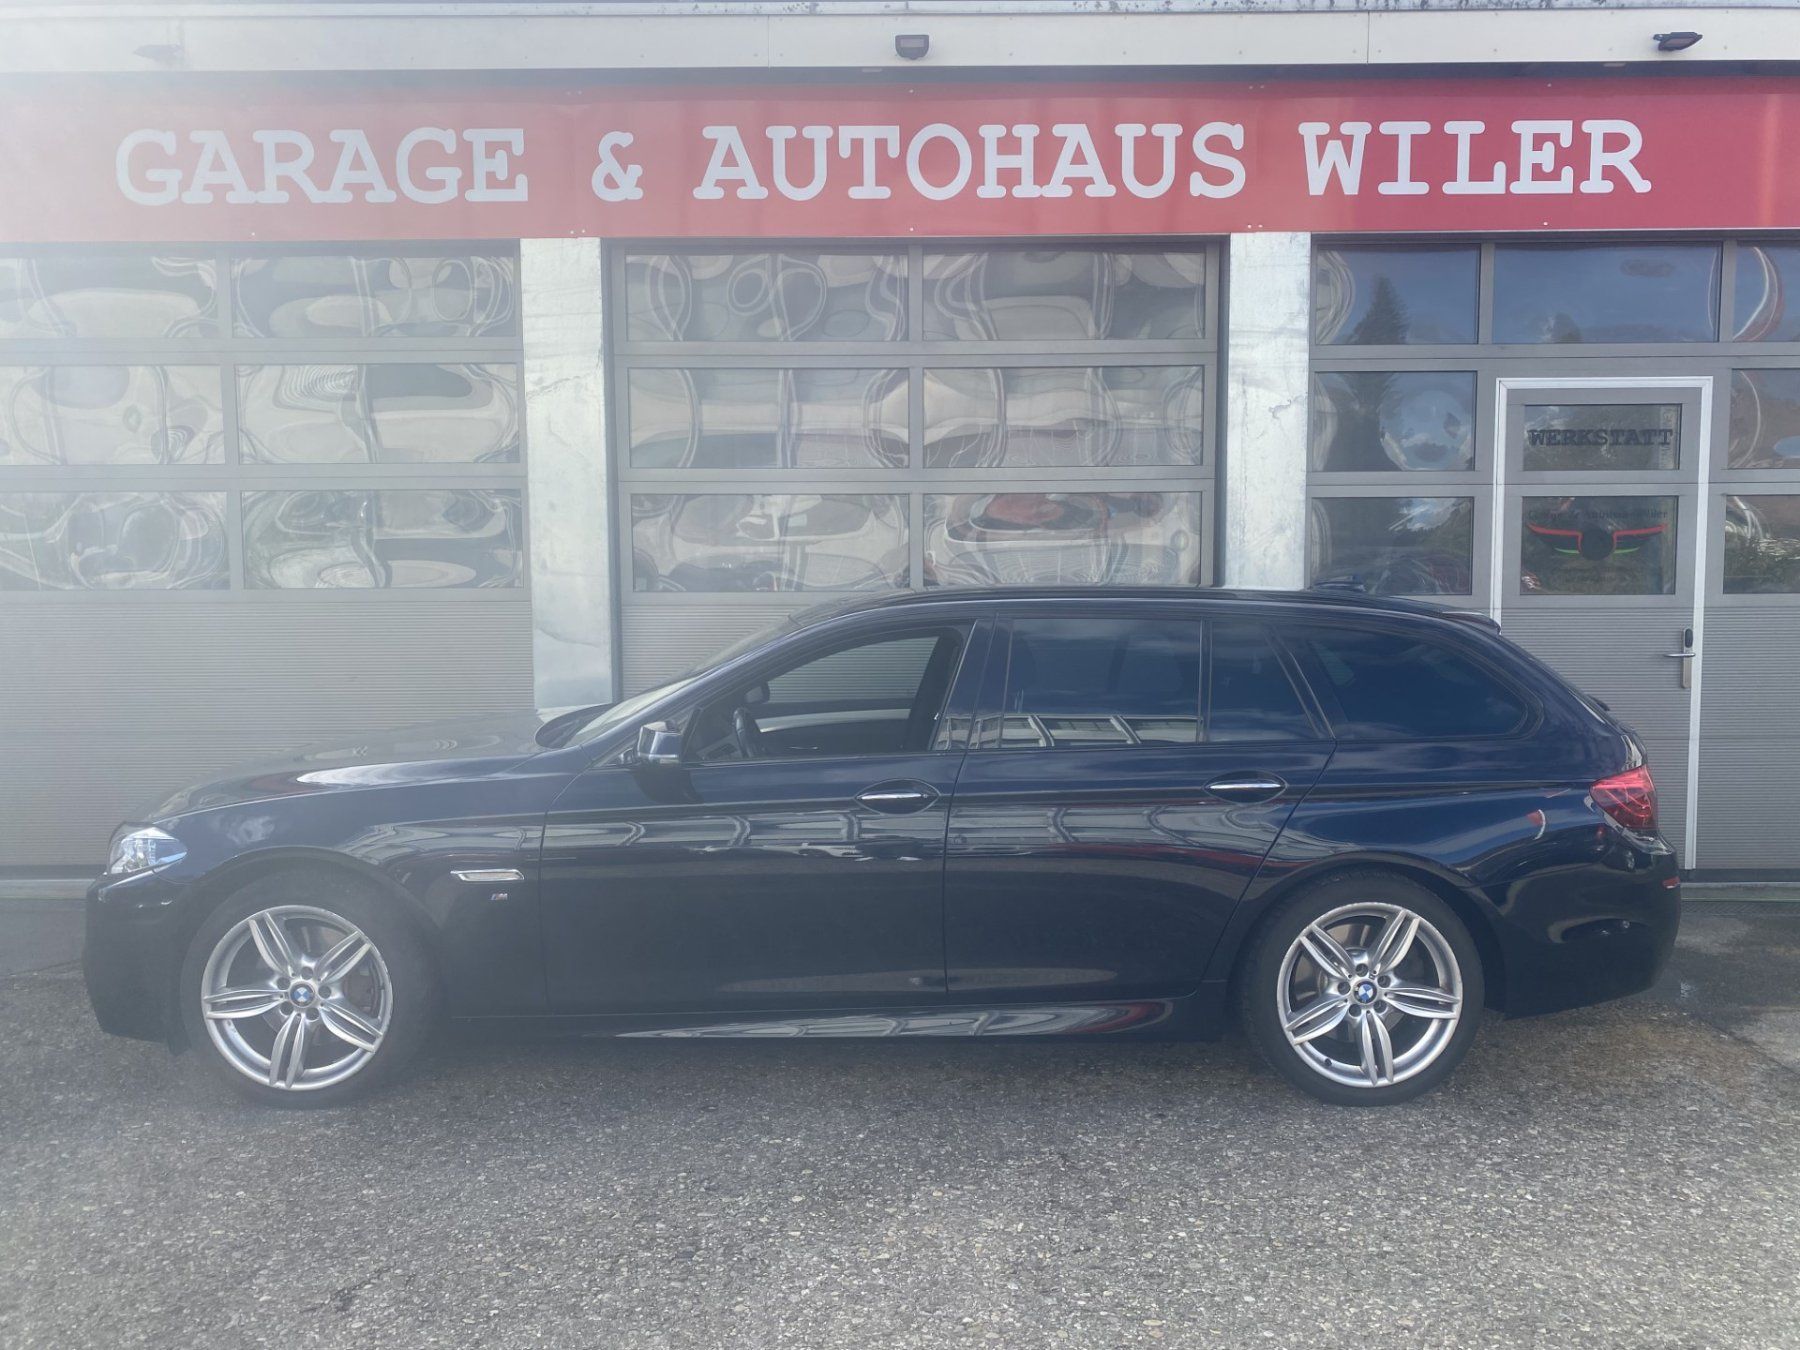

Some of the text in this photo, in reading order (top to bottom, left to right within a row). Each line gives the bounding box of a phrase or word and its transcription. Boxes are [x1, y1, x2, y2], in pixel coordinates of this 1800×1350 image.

[115, 119, 1652, 205] GARAGE & AUTOHAUS WILER
[1527, 429, 1673, 446] WERKSTATT
